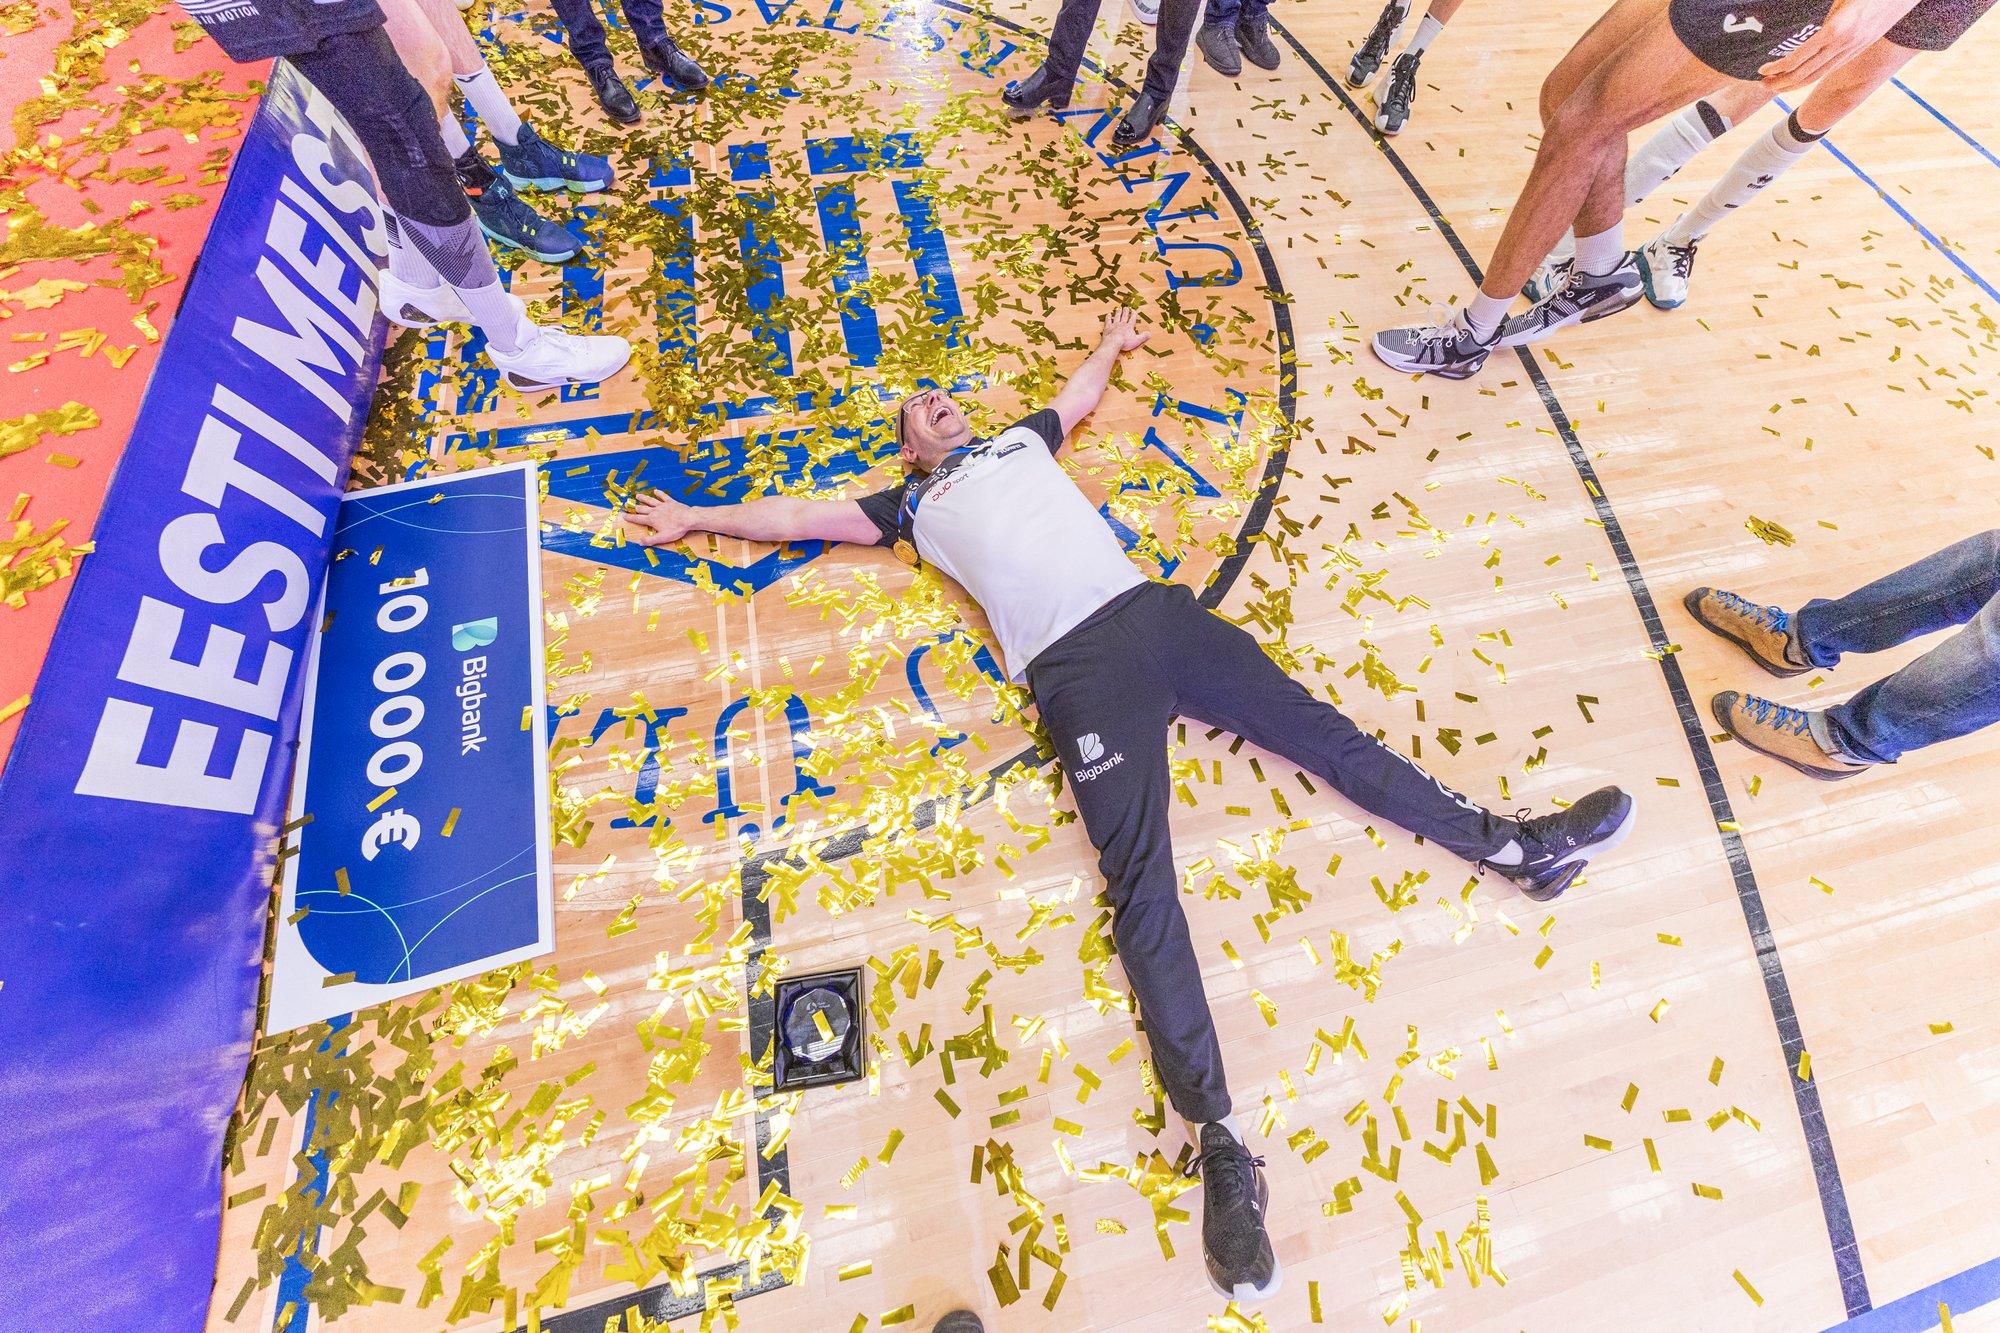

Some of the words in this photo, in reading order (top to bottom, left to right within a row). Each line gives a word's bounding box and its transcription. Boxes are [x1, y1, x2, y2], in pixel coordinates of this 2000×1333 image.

[216, 7, 259, 23] MOTION
[931, 481, 952, 502] DUO
[952, 473, 969, 484] sport
[73, 382, 340, 815] EESTI
[376, 566, 430, 634] 10
[365, 651, 427, 788] 000
[455, 655, 487, 756] Bigbank
[1075, 753, 1125, 783] Bigbank
[361, 806, 421, 862] €
